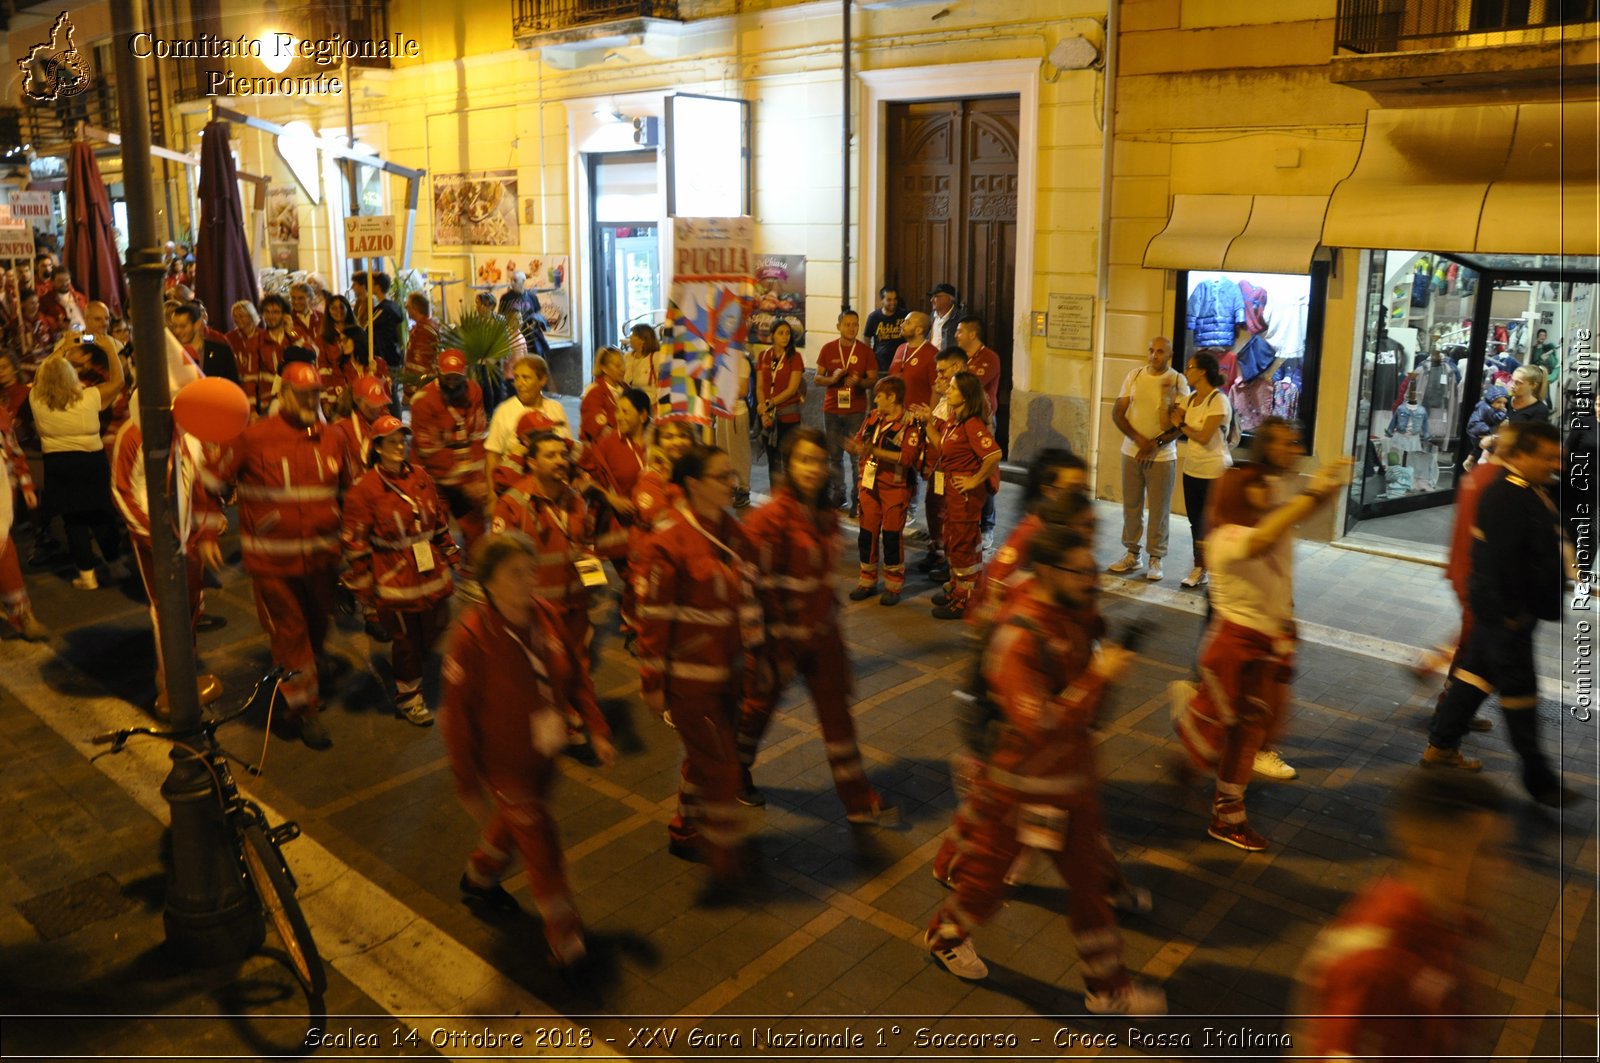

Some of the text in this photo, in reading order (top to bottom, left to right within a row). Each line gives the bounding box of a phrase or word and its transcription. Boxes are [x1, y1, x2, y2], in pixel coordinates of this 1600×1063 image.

[13, 204, 49, 216] UMBRIA
[0, 242, 33, 255] ENETO
[349, 234, 394, 253] LAZIO
[676, 247, 750, 274] PUGLIA
